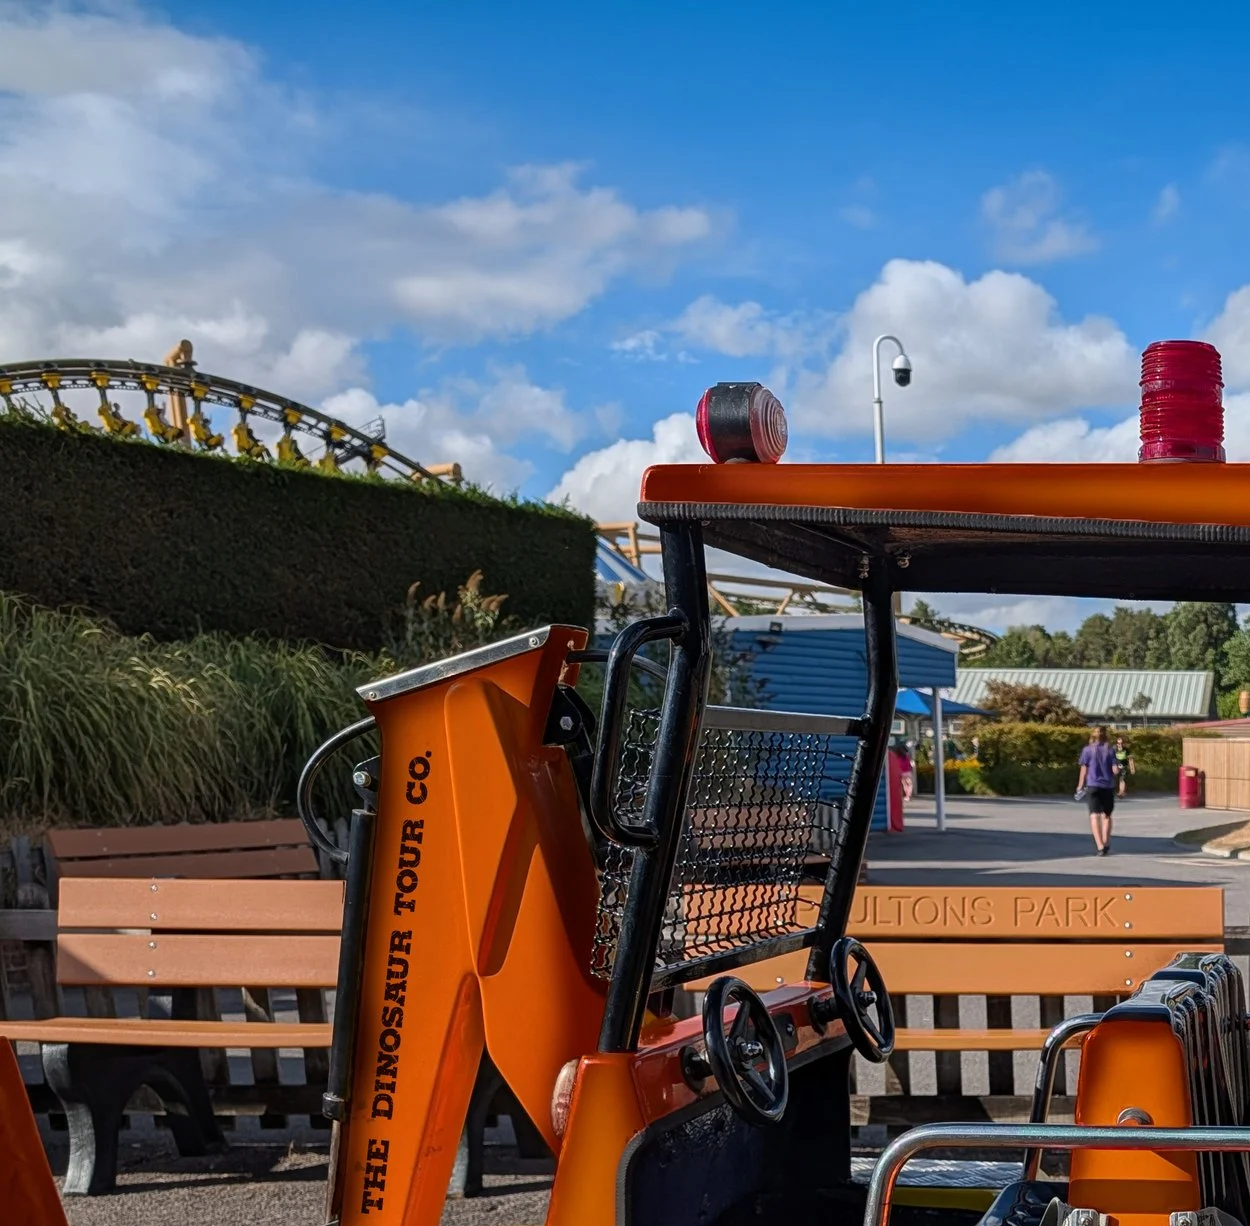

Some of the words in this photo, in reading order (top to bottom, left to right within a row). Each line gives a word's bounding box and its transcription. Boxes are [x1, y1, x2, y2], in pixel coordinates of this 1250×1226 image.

[405, 750, 432, 806] CO.
[394, 819, 424, 916] TOUR
[1013, 896, 1119, 928] PARK
[371, 929, 413, 1121] DINOSAUR
[361, 1138, 390, 1215] THE
